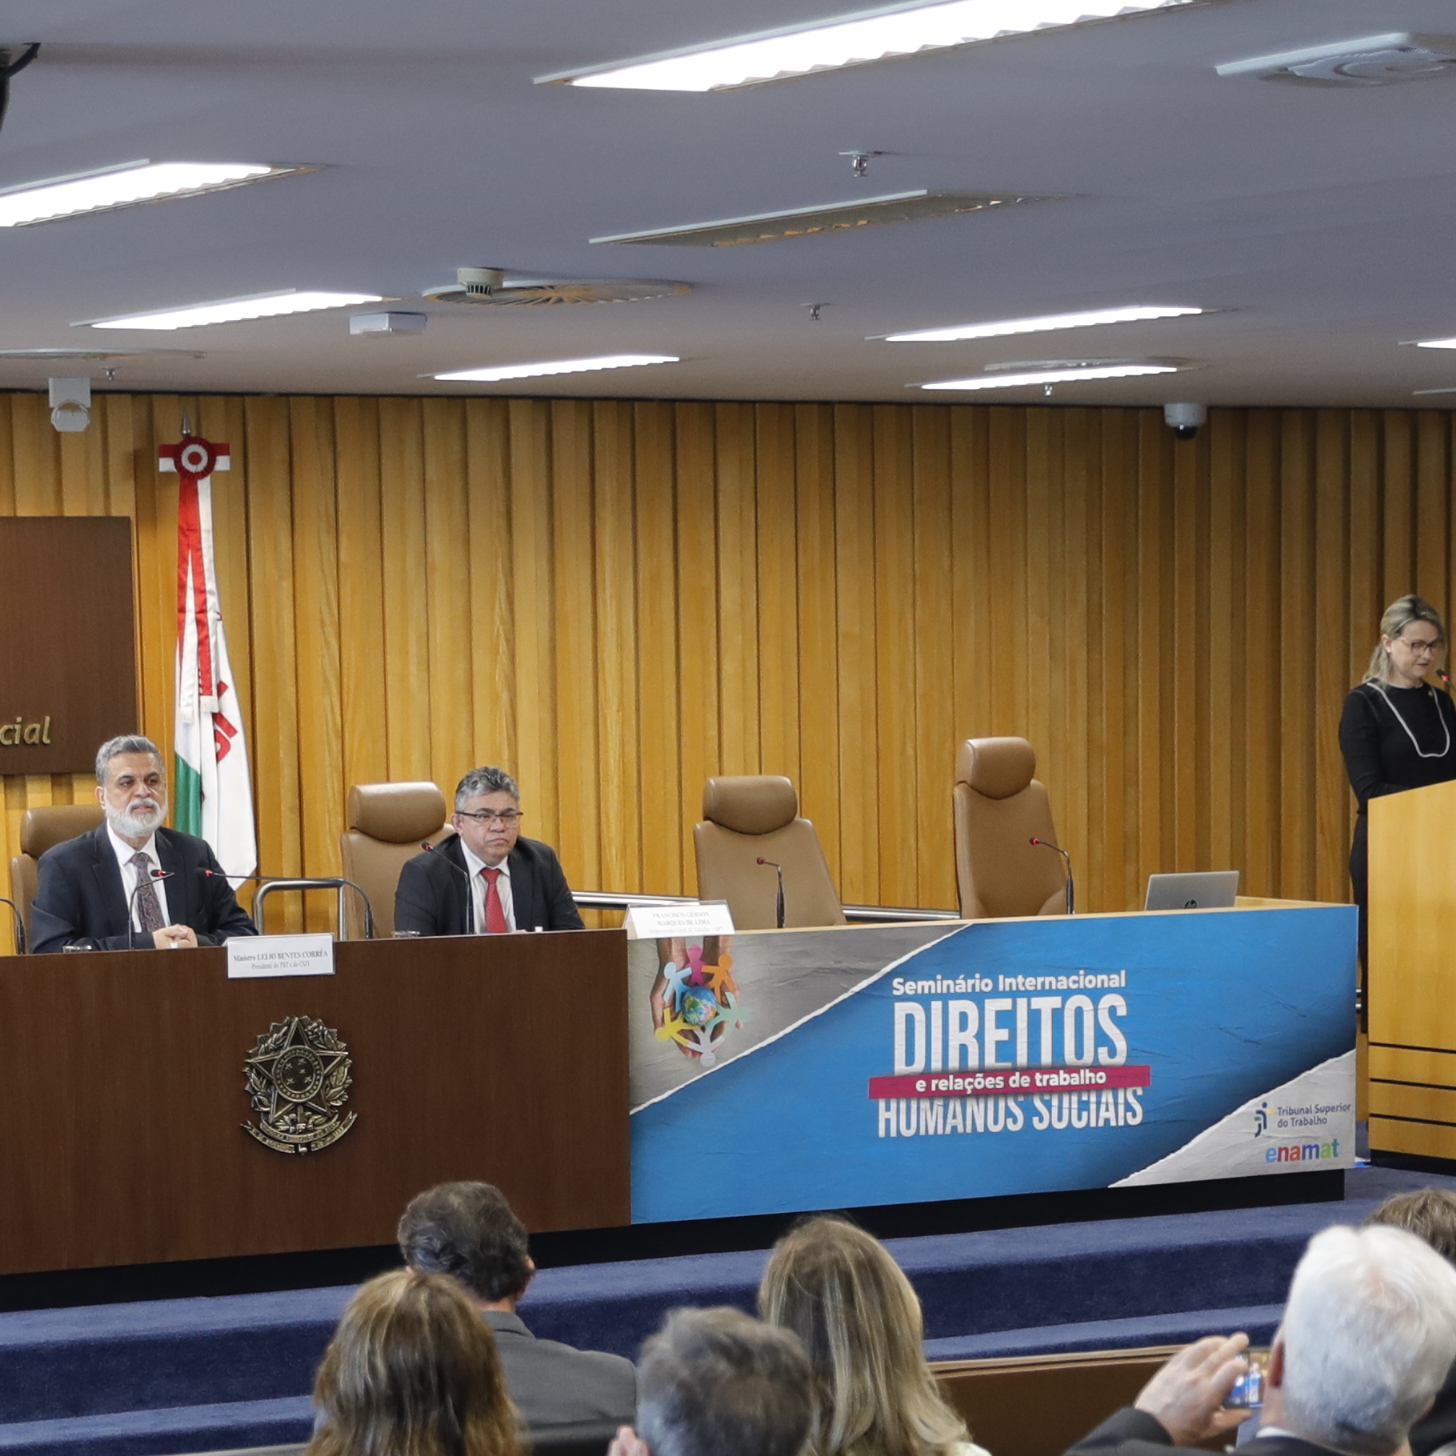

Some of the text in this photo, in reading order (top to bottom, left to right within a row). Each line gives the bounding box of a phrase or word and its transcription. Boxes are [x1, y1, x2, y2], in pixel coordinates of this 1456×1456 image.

[892, 969, 1126, 996] Seminário Internacional
[893, 993, 1128, 1077] DIREITOS
[915, 1068, 1107, 1094] e relações de trabalho
[1277, 1102, 1351, 1116] Tribunal Superior
[1277, 1115, 1327, 1128] do Trabalho
[1265, 1138, 1340, 1163] enamat
